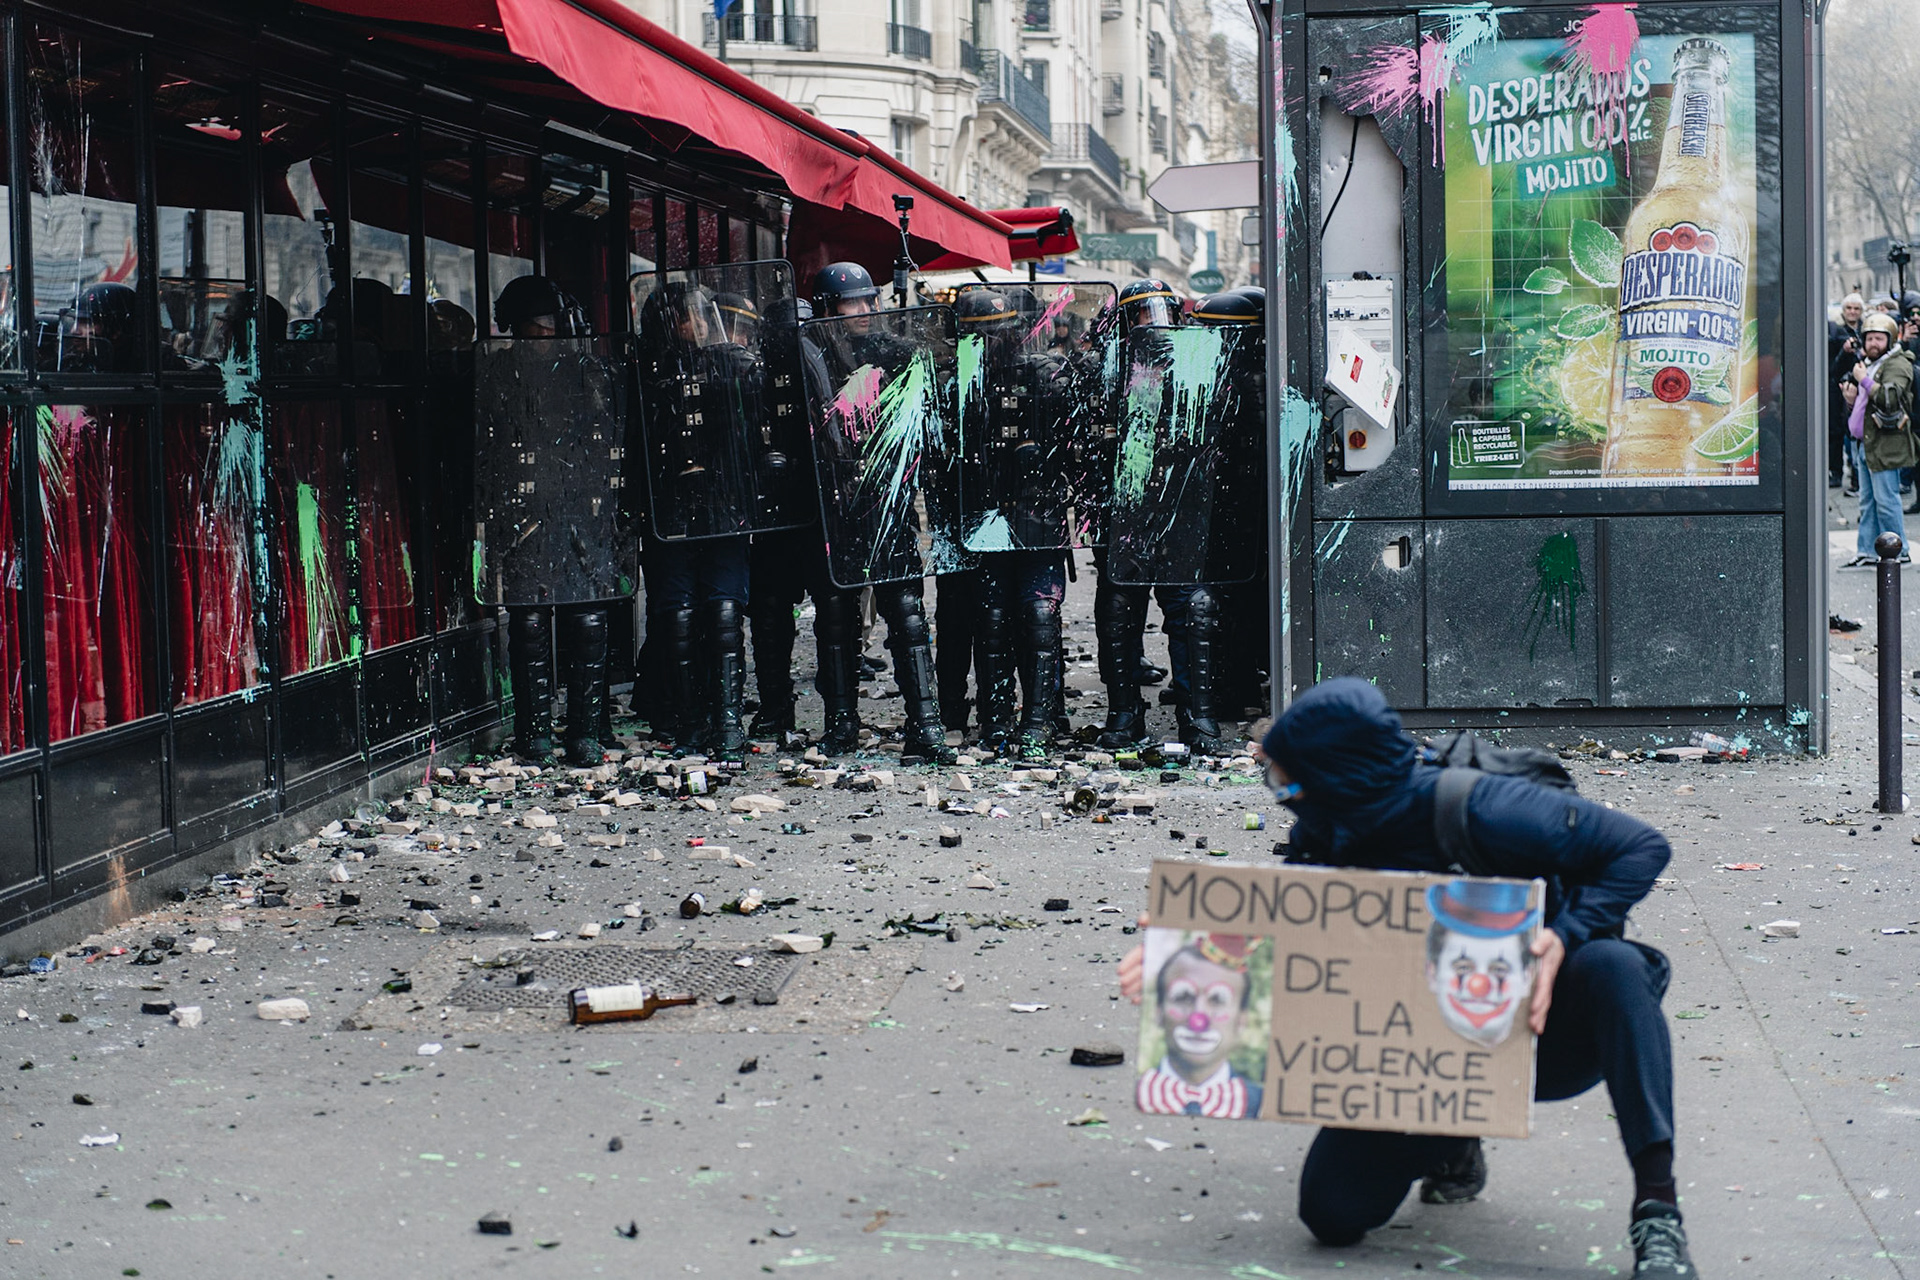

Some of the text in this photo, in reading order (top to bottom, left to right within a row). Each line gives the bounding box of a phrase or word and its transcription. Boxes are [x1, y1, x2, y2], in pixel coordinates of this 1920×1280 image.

[1471, 112, 1575, 167] VIRGIN
[1680, 93, 1710, 156] DESPERADOS
[1621, 252, 1742, 307] DESPERADOS
[1626, 311, 1690, 336] VIRGIN
[1639, 348, 1711, 367] MOJITO
[1472, 426, 1511, 436] BOUTEILLES
[1473, 441, 1518, 450] RECYCLABLES
[1478, 434, 1512, 443] CAPSULES
[1156, 871, 1427, 934] MONOPOLE
[1285, 953, 1351, 994] DE
[1354, 1001, 1413, 1037] LA
